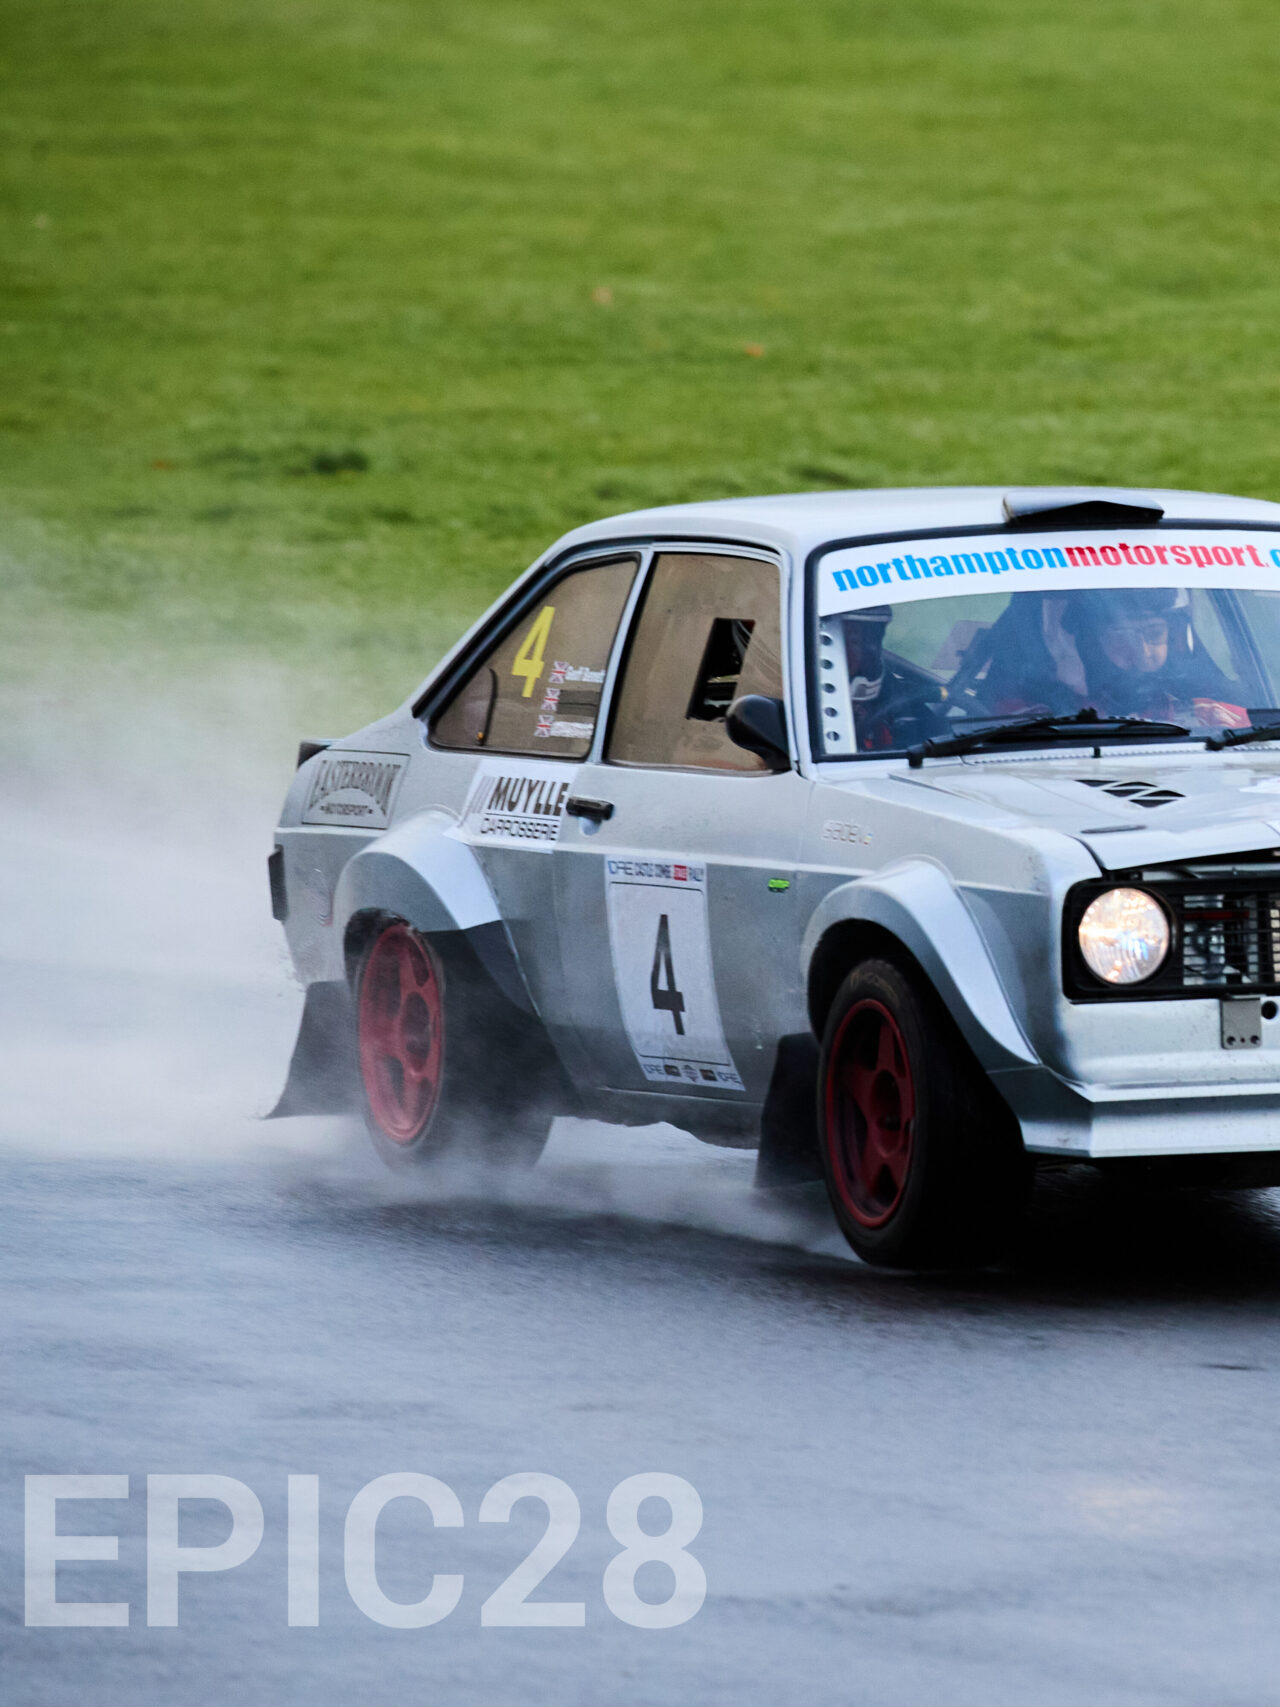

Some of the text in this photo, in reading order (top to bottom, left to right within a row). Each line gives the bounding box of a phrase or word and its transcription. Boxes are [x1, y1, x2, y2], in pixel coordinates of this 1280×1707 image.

[511, 605, 556, 698] 4
[487, 776, 571, 817] MUYLLE
[650, 913, 686, 1036] 4
